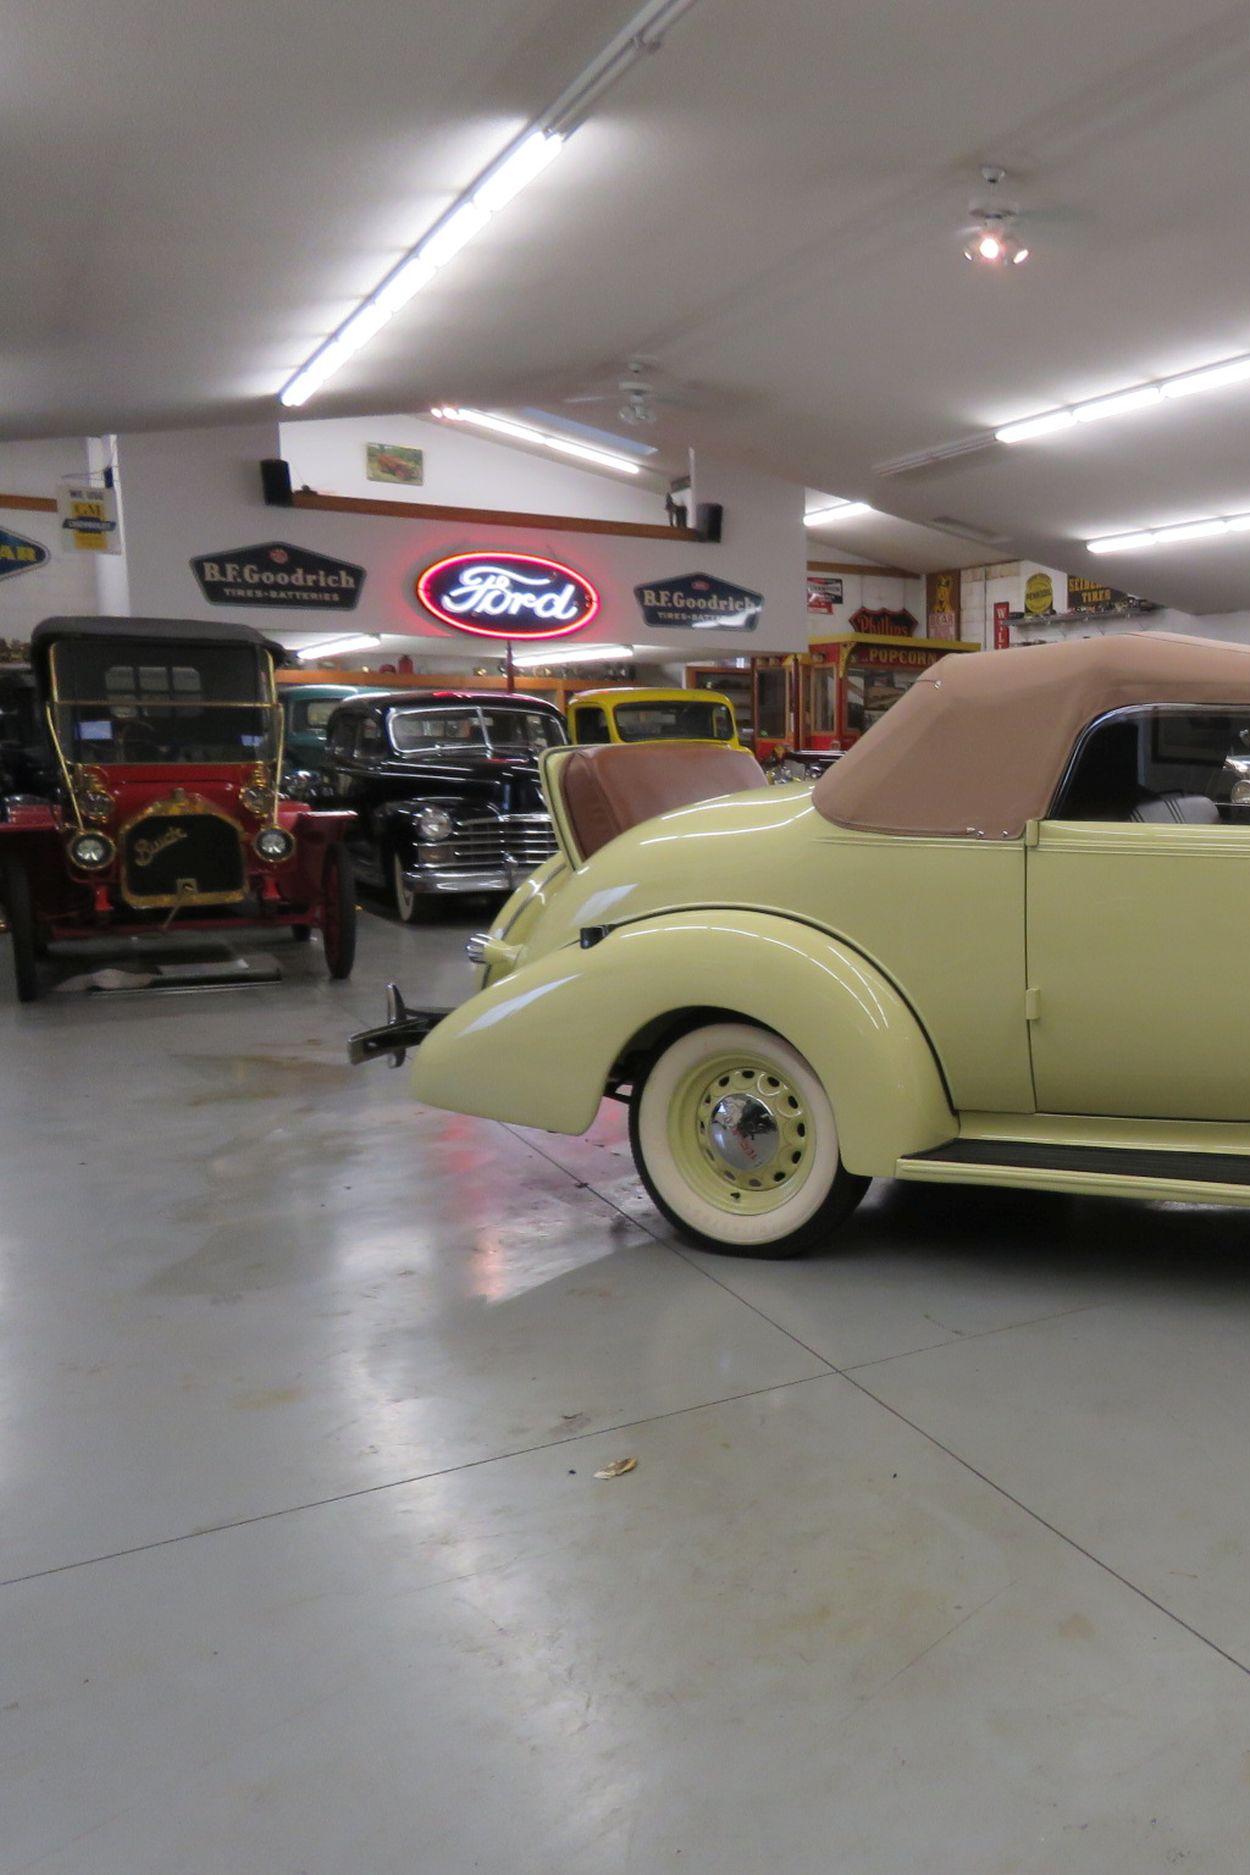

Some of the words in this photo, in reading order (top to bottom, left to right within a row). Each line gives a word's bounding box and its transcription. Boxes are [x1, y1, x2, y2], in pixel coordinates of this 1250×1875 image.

[441, 565, 578, 620] Ford
[1081, 587, 1110, 603] TIRES
[868, 647, 938, 668] POPCORN
